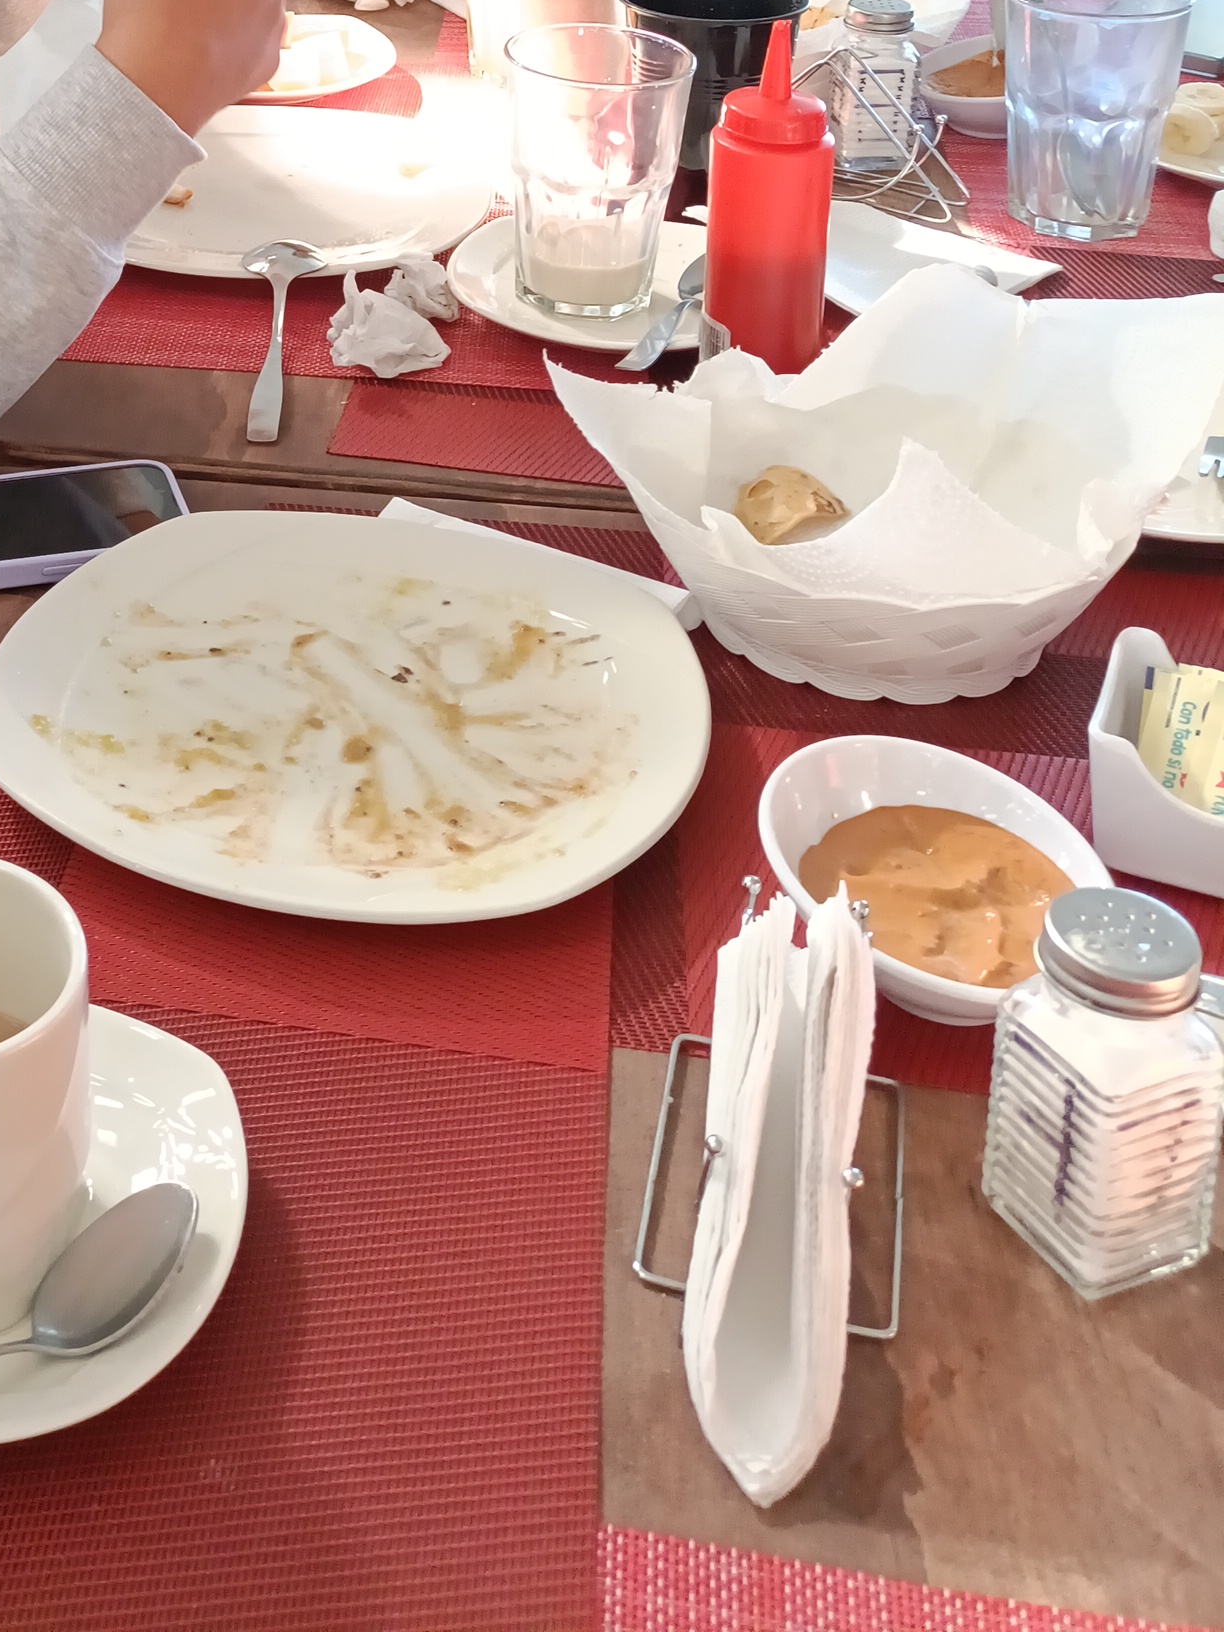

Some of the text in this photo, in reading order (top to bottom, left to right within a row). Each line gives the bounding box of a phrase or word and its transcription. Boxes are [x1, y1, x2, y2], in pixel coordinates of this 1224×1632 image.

[1178, 701, 1197, 725] Con
[1170, 728, 1192, 756] todo
[1162, 771, 1177, 789] no
